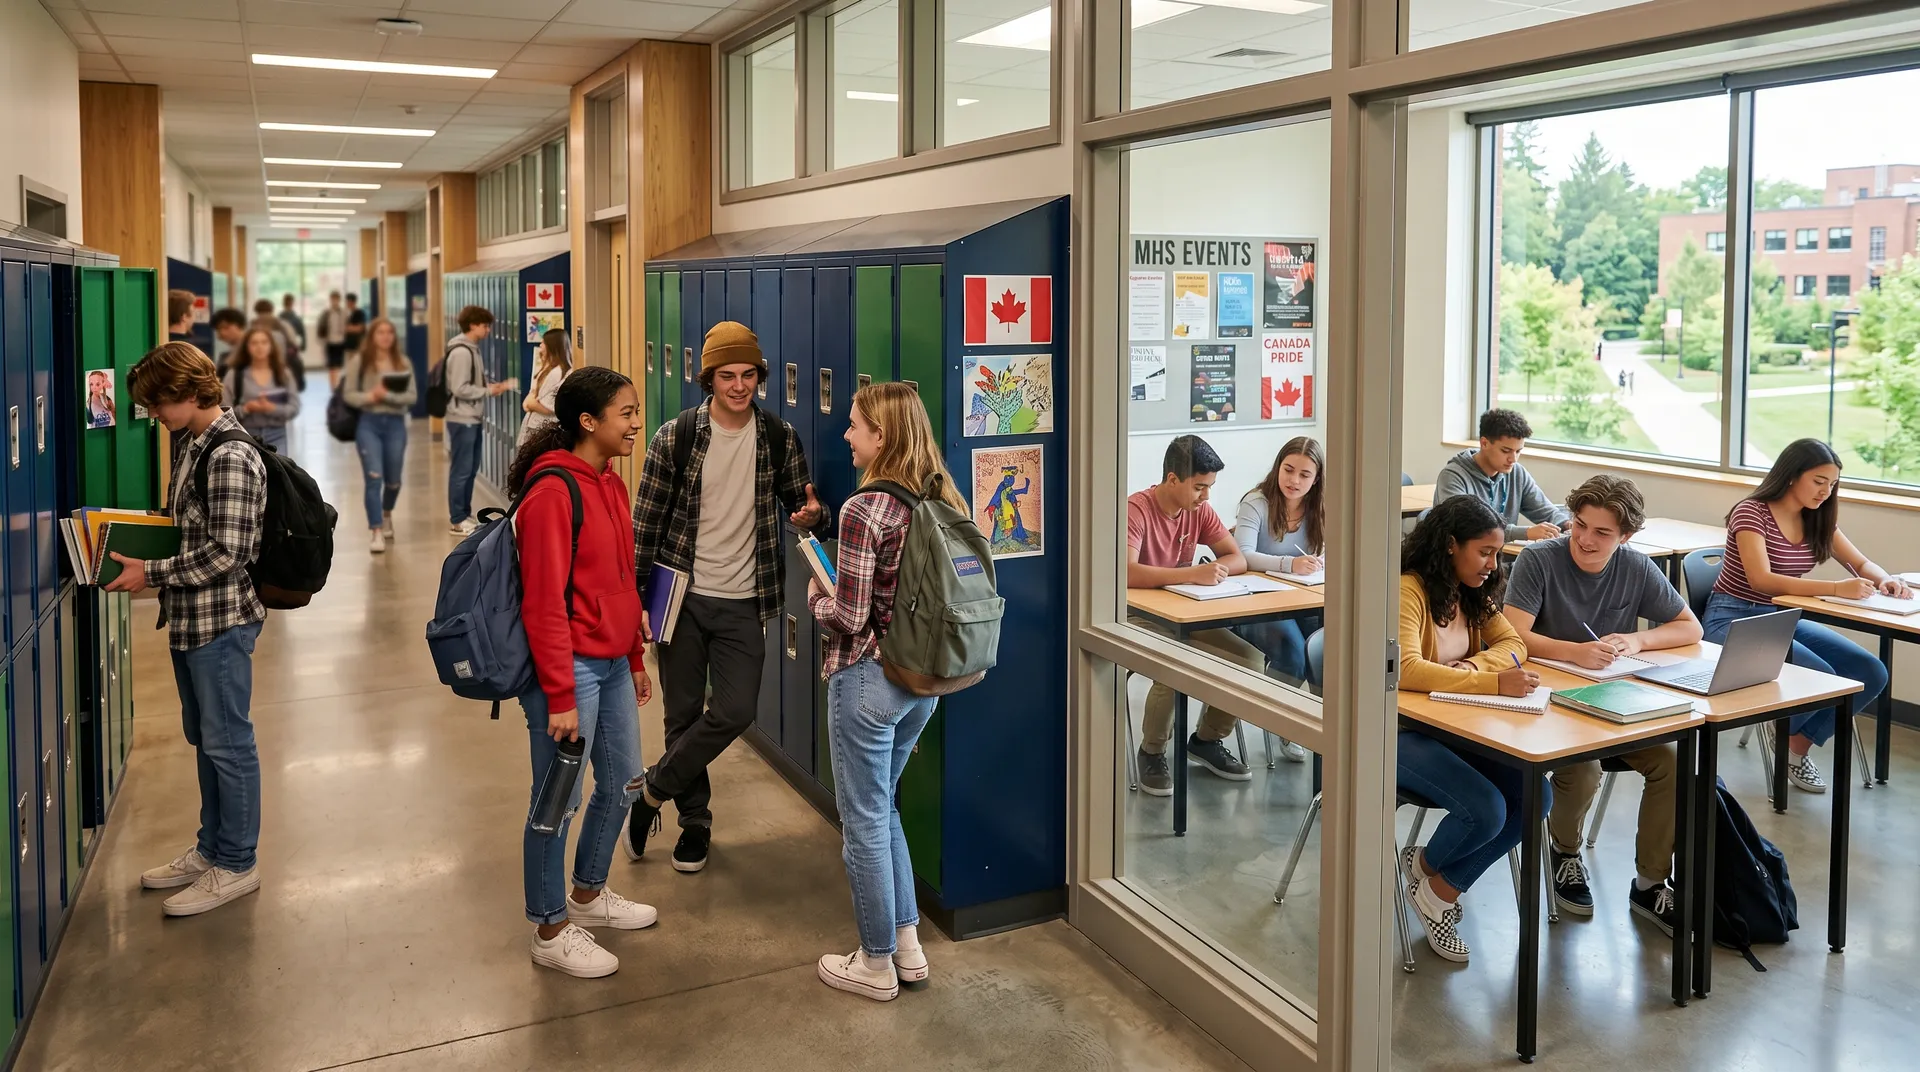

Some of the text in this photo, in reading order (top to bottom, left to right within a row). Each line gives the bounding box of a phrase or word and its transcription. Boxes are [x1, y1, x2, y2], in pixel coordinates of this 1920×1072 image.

[1135, 240, 1175, 265] MHS
[1183, 240, 1251, 266] EVENTS
[1264, 338, 1311, 349] CANADA
[1271, 351, 1304, 363] PRIDE
